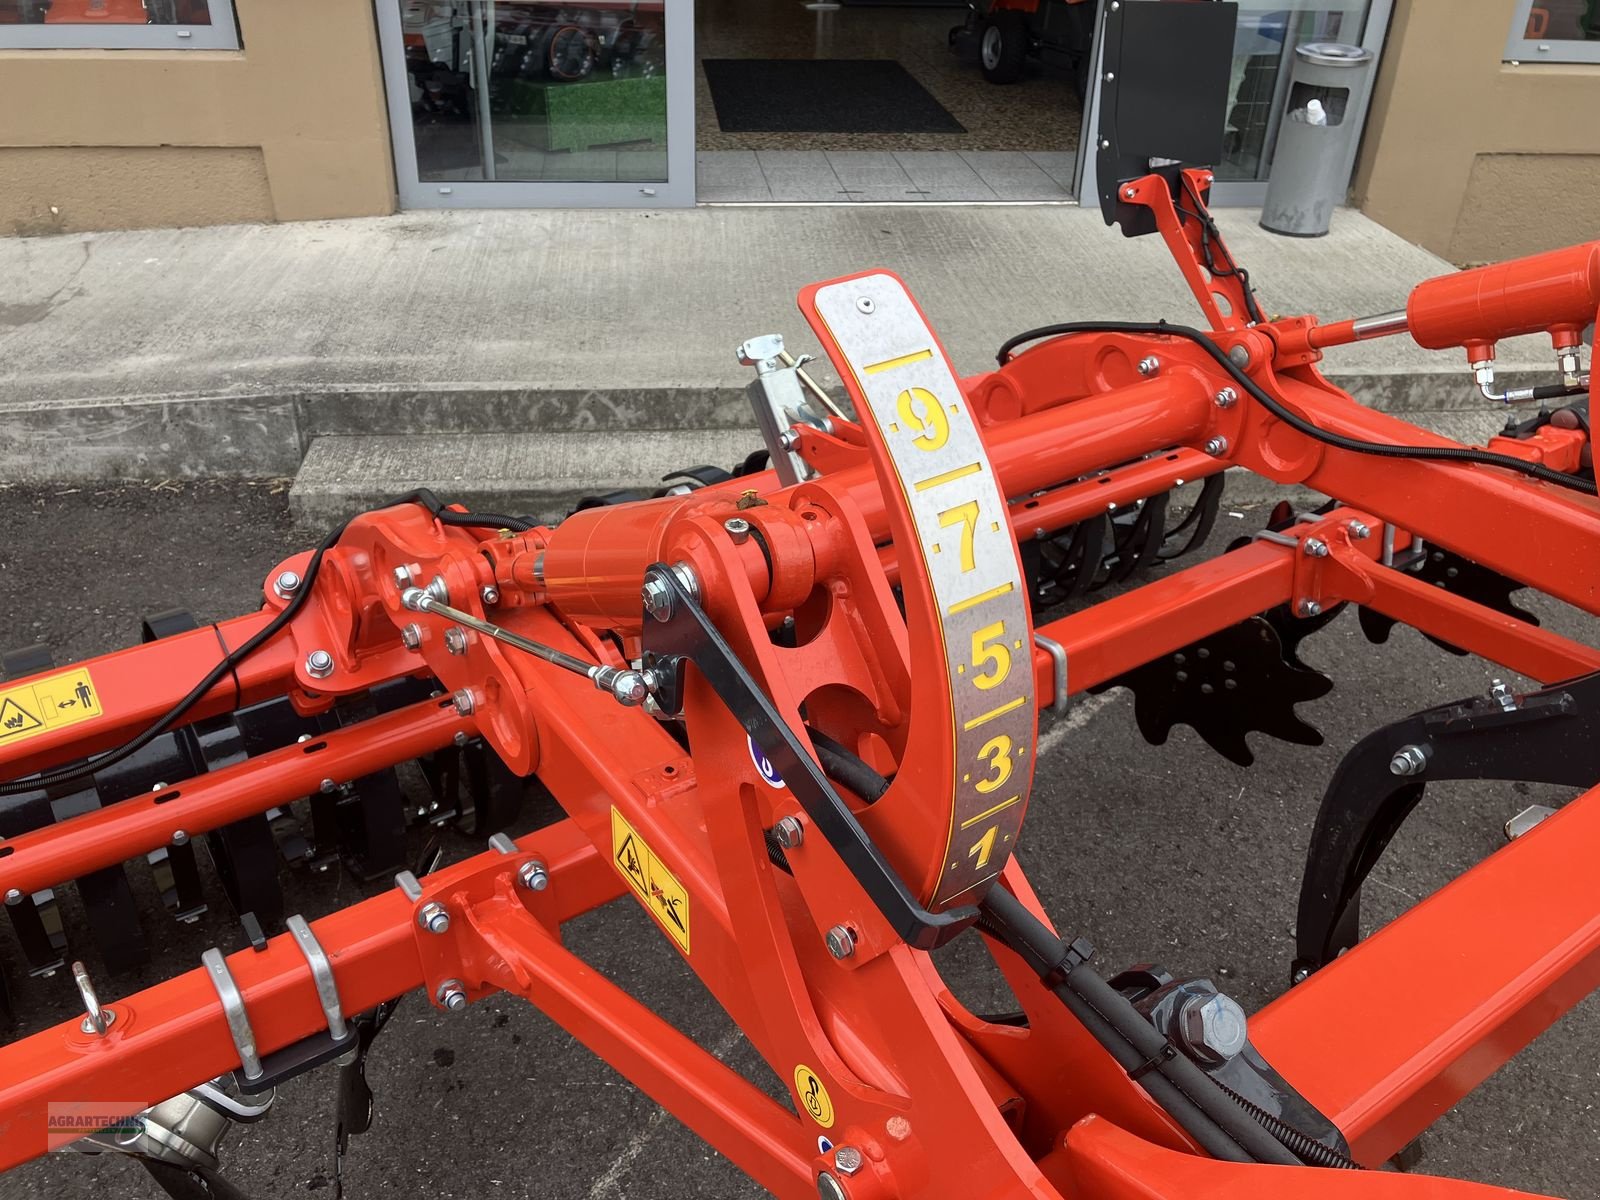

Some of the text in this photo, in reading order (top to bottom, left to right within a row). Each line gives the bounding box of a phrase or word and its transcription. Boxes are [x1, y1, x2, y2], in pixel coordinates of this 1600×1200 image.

[897, 387, 950, 452] 9
[937, 500, 980, 573] 7
[971, 620, 1011, 690] 5
[975, 735, 1013, 794] 3
[968, 825, 999, 870] 1
